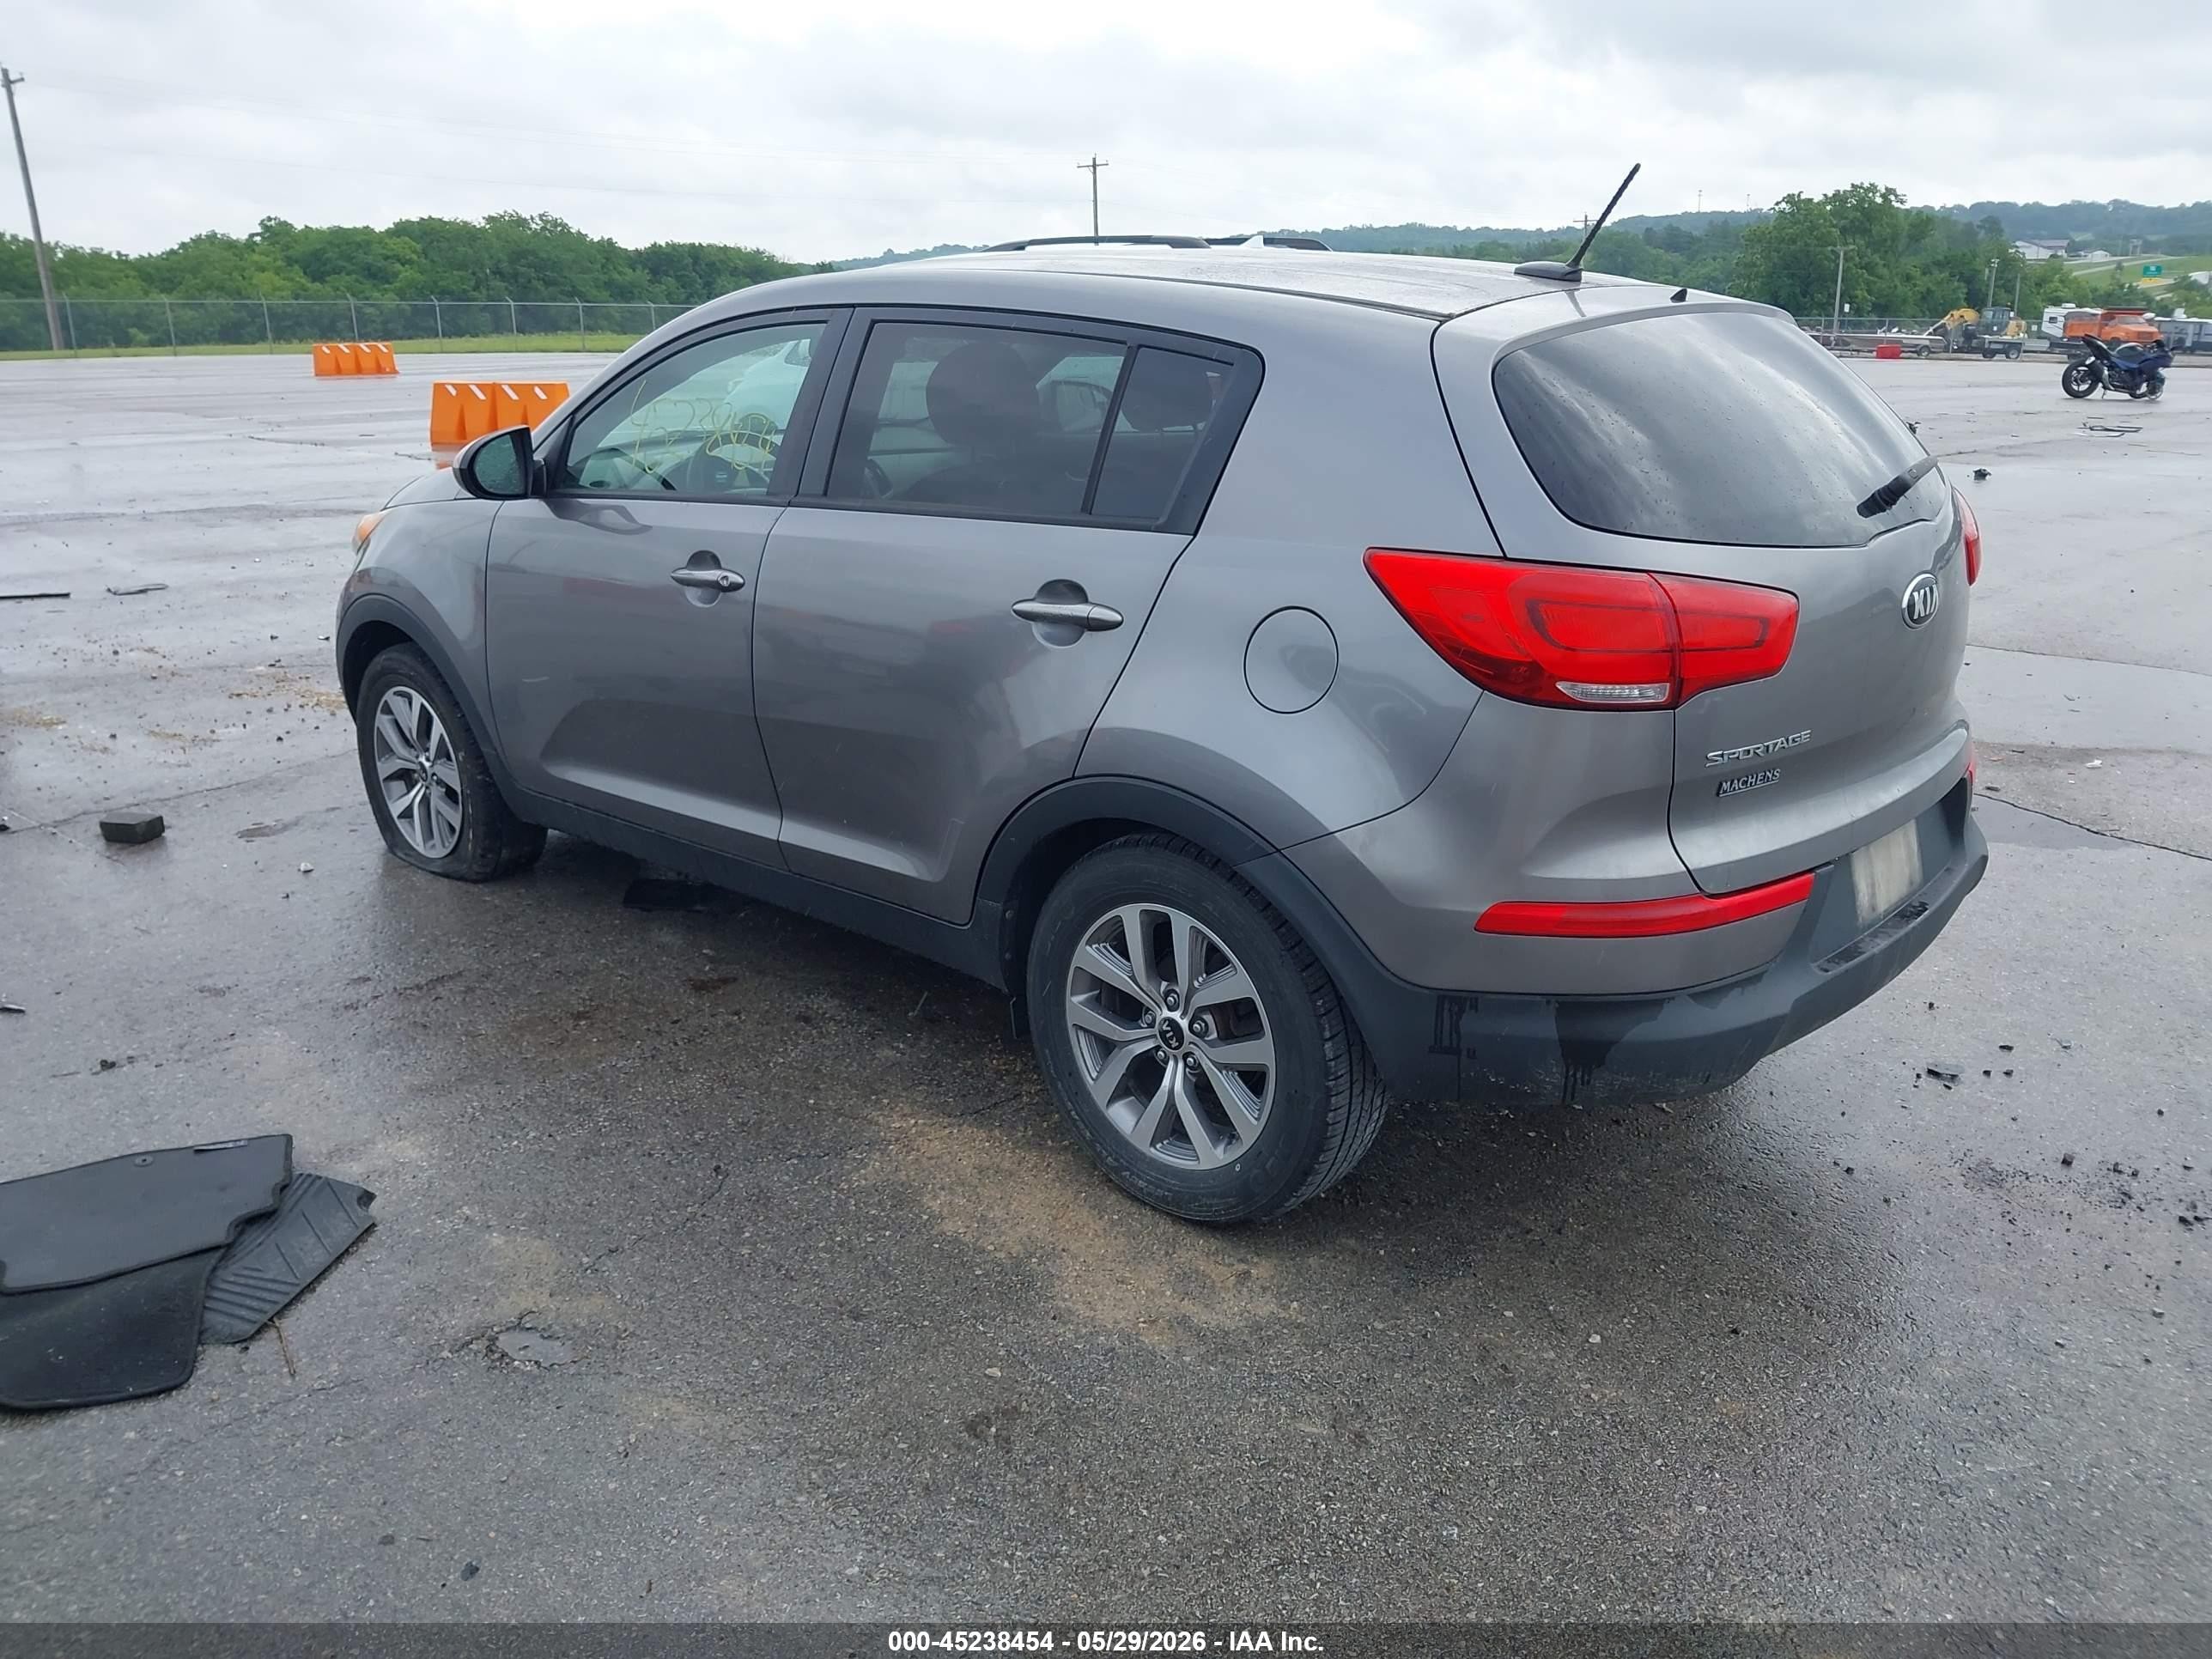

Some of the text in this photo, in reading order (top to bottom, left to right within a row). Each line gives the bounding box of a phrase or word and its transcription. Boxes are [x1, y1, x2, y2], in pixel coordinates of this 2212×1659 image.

[1911, 584, 1939, 620] KIA
[1705, 729, 1812, 767] SPORTAGE
[1718, 769, 1781, 795] MACHENS
[1162, 1019, 1179, 1048] KIA
